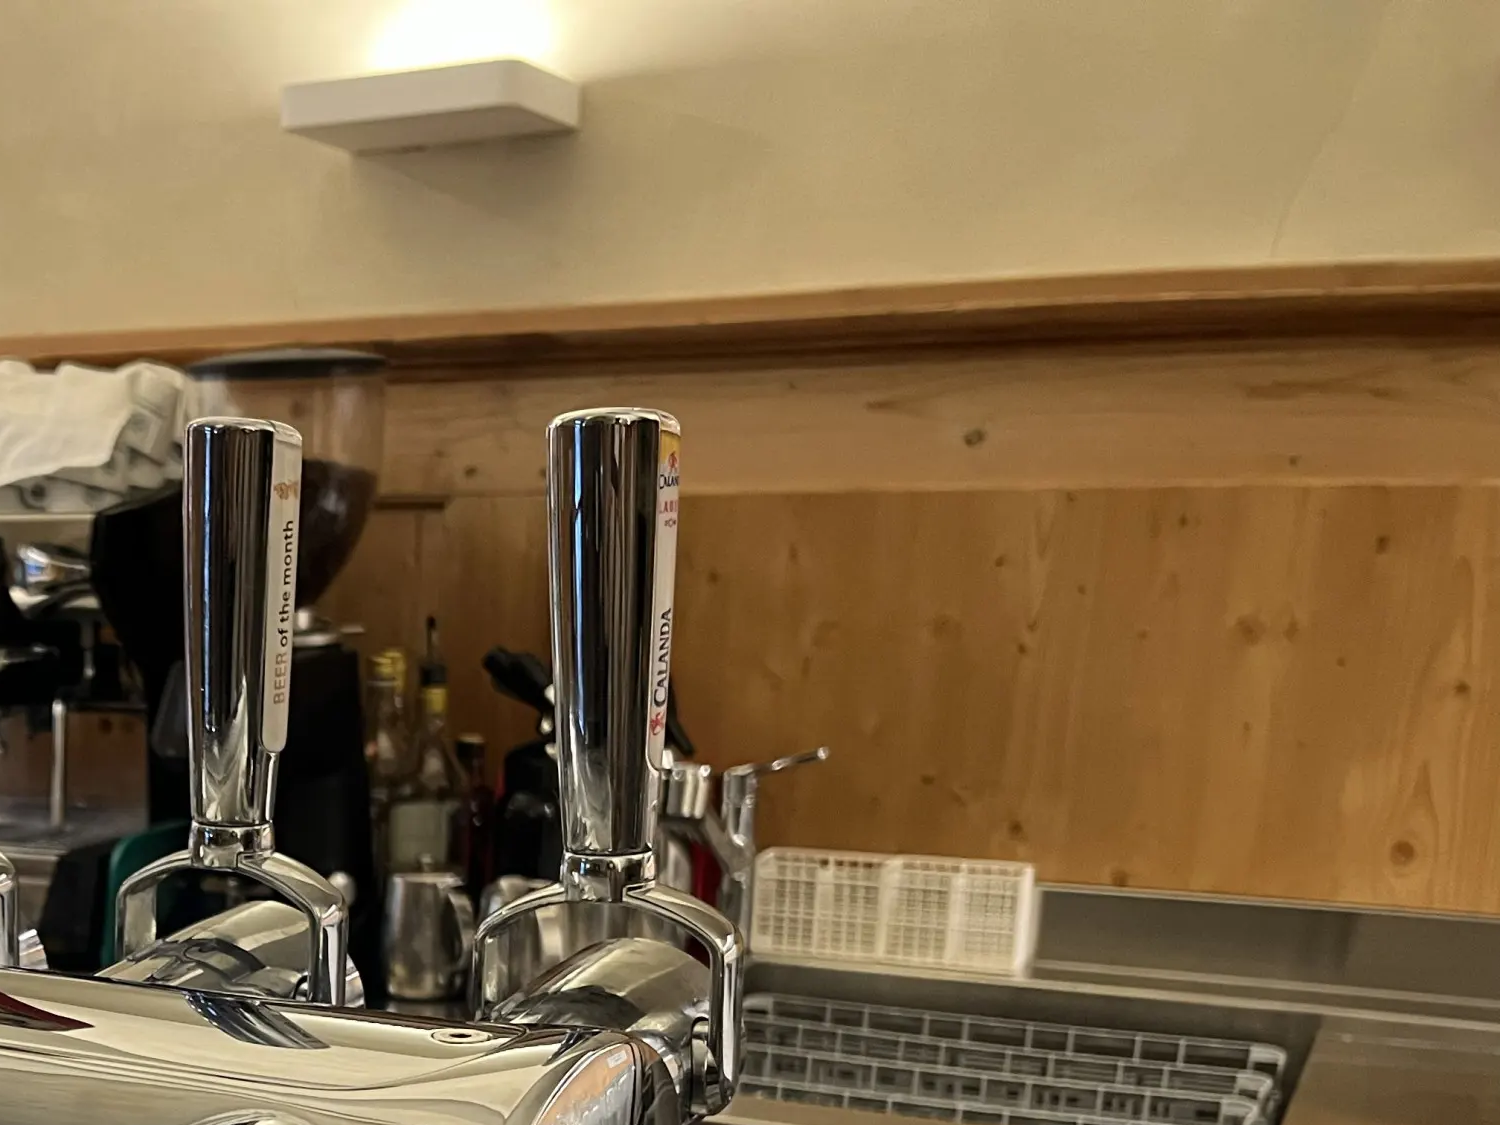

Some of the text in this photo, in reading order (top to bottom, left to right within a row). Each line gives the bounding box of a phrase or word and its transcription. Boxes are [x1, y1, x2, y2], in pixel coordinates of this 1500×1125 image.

[273, 520, 294, 705] BEER of the month
[653, 608, 671, 707] CALANDA
